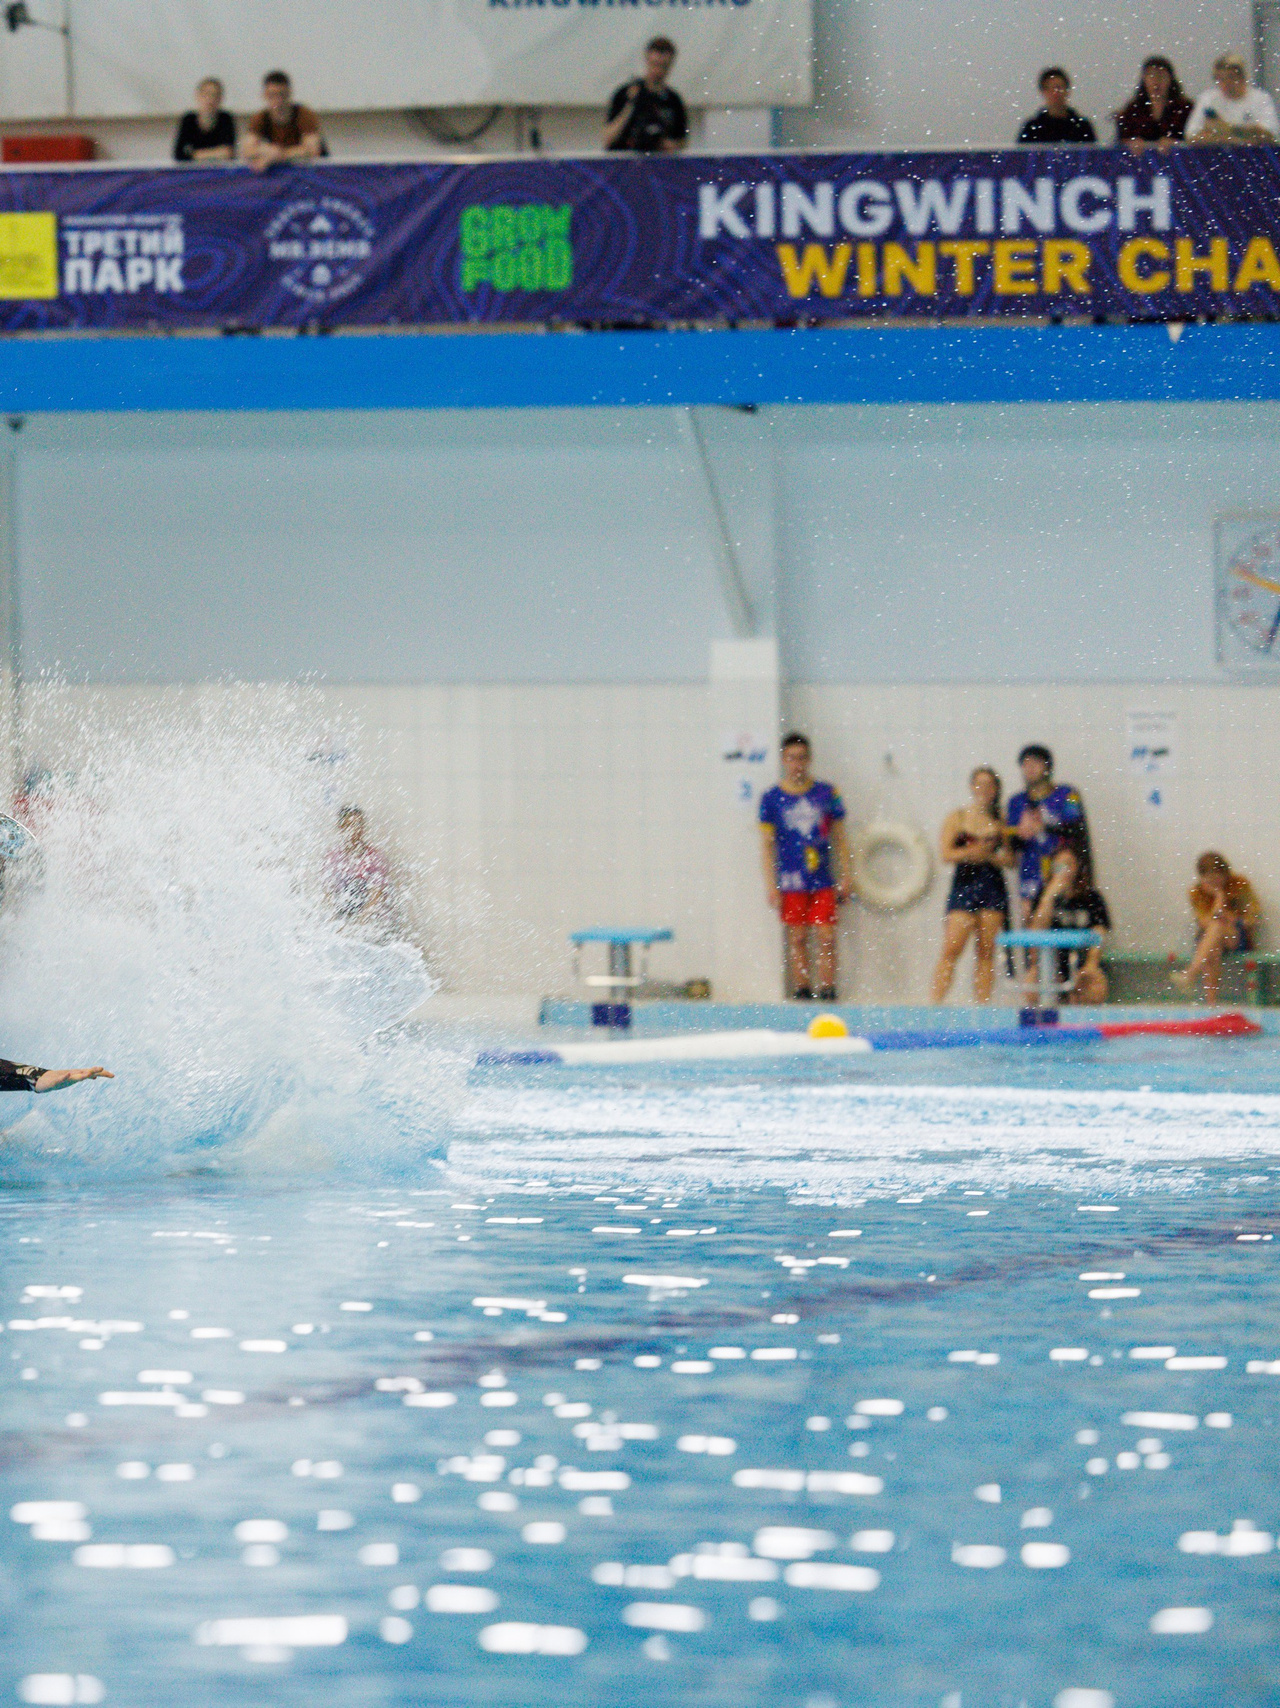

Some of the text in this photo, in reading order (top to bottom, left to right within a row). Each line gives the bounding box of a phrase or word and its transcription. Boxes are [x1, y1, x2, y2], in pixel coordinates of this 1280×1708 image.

[697, 174, 1172, 239] KINGWINCH
[63, 220, 185, 256] ТРЕТИЙ
[460, 238, 573, 292] FOOD
[63, 257, 186, 294] ПАРК
[776, 235, 1280, 298] WINTER CHA
